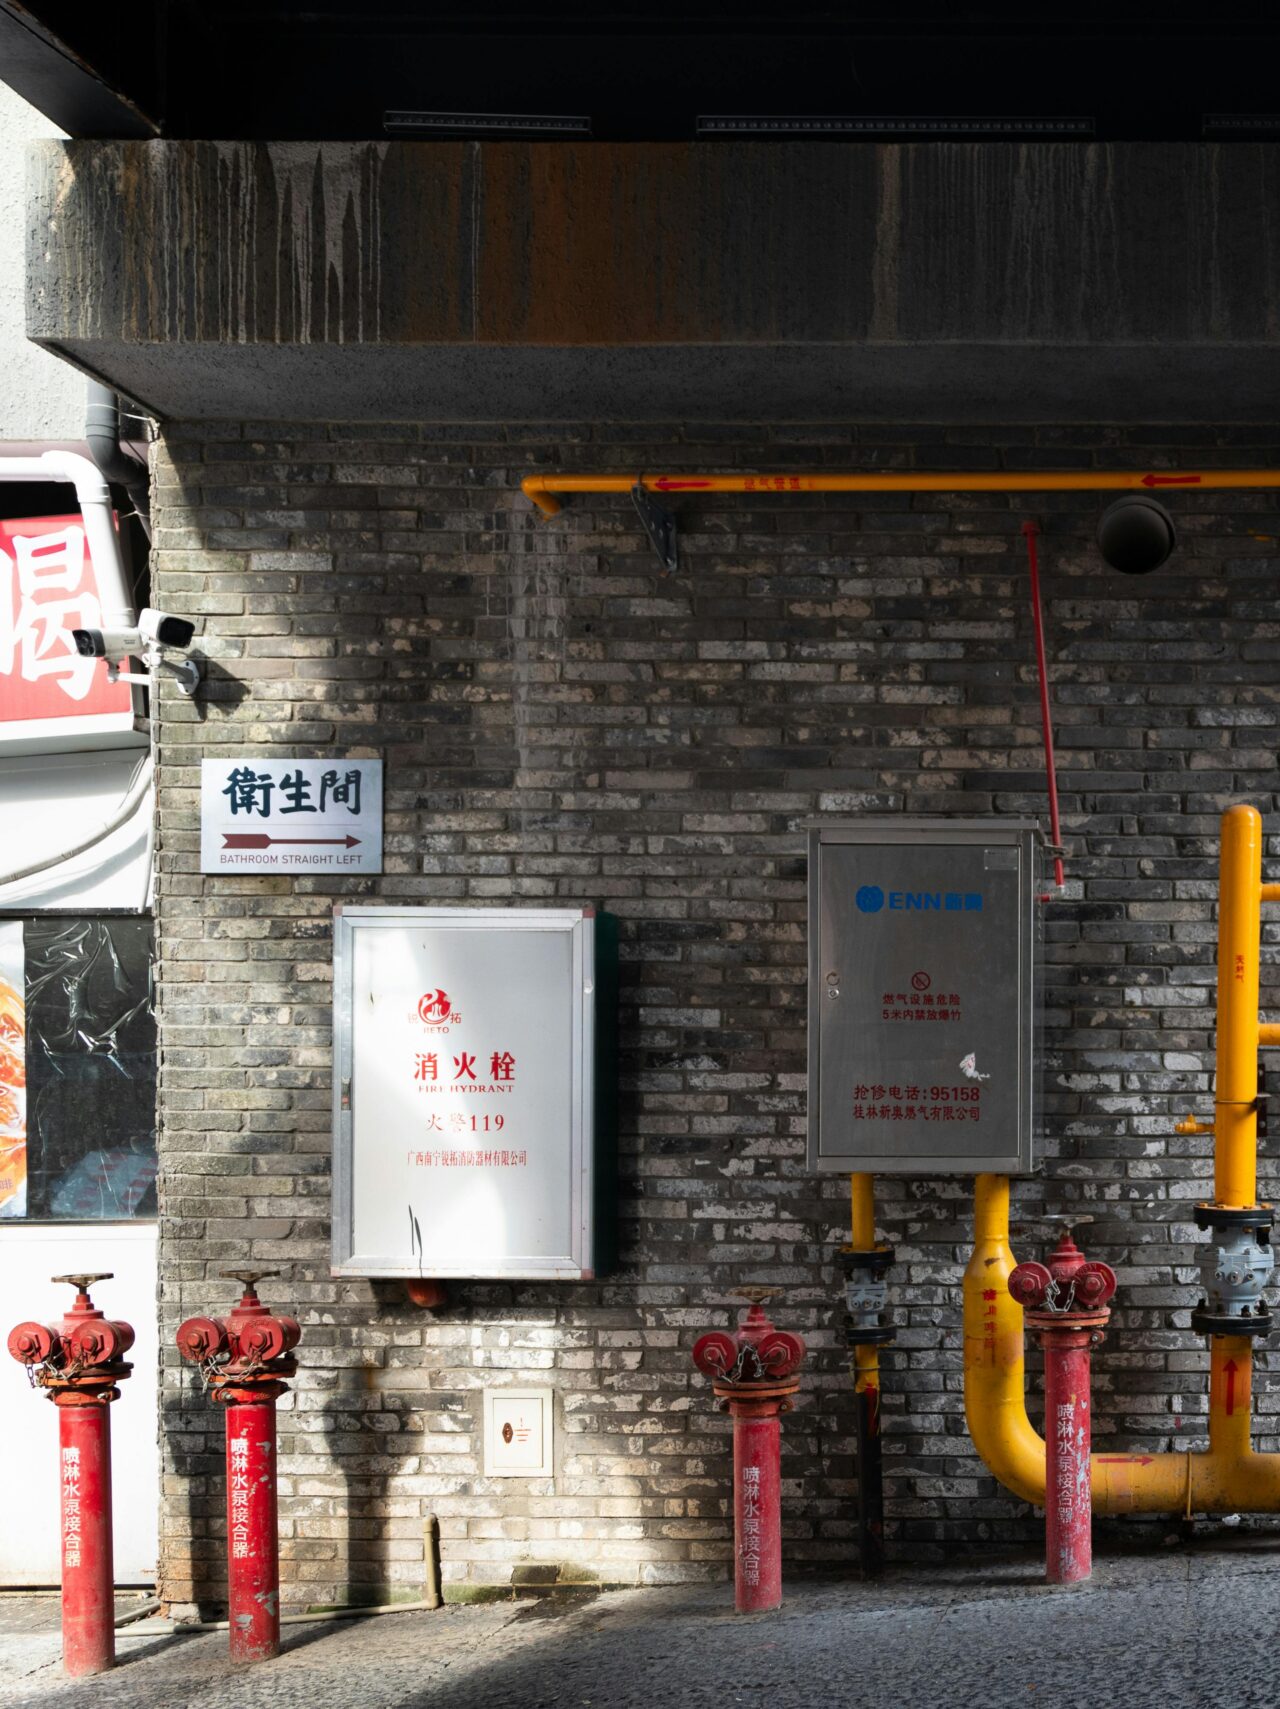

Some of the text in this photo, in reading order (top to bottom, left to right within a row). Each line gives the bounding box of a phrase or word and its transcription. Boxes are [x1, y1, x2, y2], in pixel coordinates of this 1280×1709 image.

[222, 766, 362, 818] 衛生間
[220, 855, 363, 865] BATHROOM STRAIGHT LEFT
[888, 892, 941, 911] ENN
[882, 993, 961, 1006] 燃气设施危险
[882, 1009, 962, 1021] 5米内禁放爆竹
[414, 1051, 516, 1081] 消火栓
[450, 1085, 514, 1093] HYDRANT
[853, 1104, 981, 1121] 桂林新奥燃气有限公司
[1056, 1403, 1075, 1524] 喷淋水泵接合器
[62, 1446, 82, 1568] 喷淋水泵接合器
[230, 1438, 249, 1559] 喷淋水泵接合器
[742, 1466, 761, 1586] 喷淋水泵接合器
